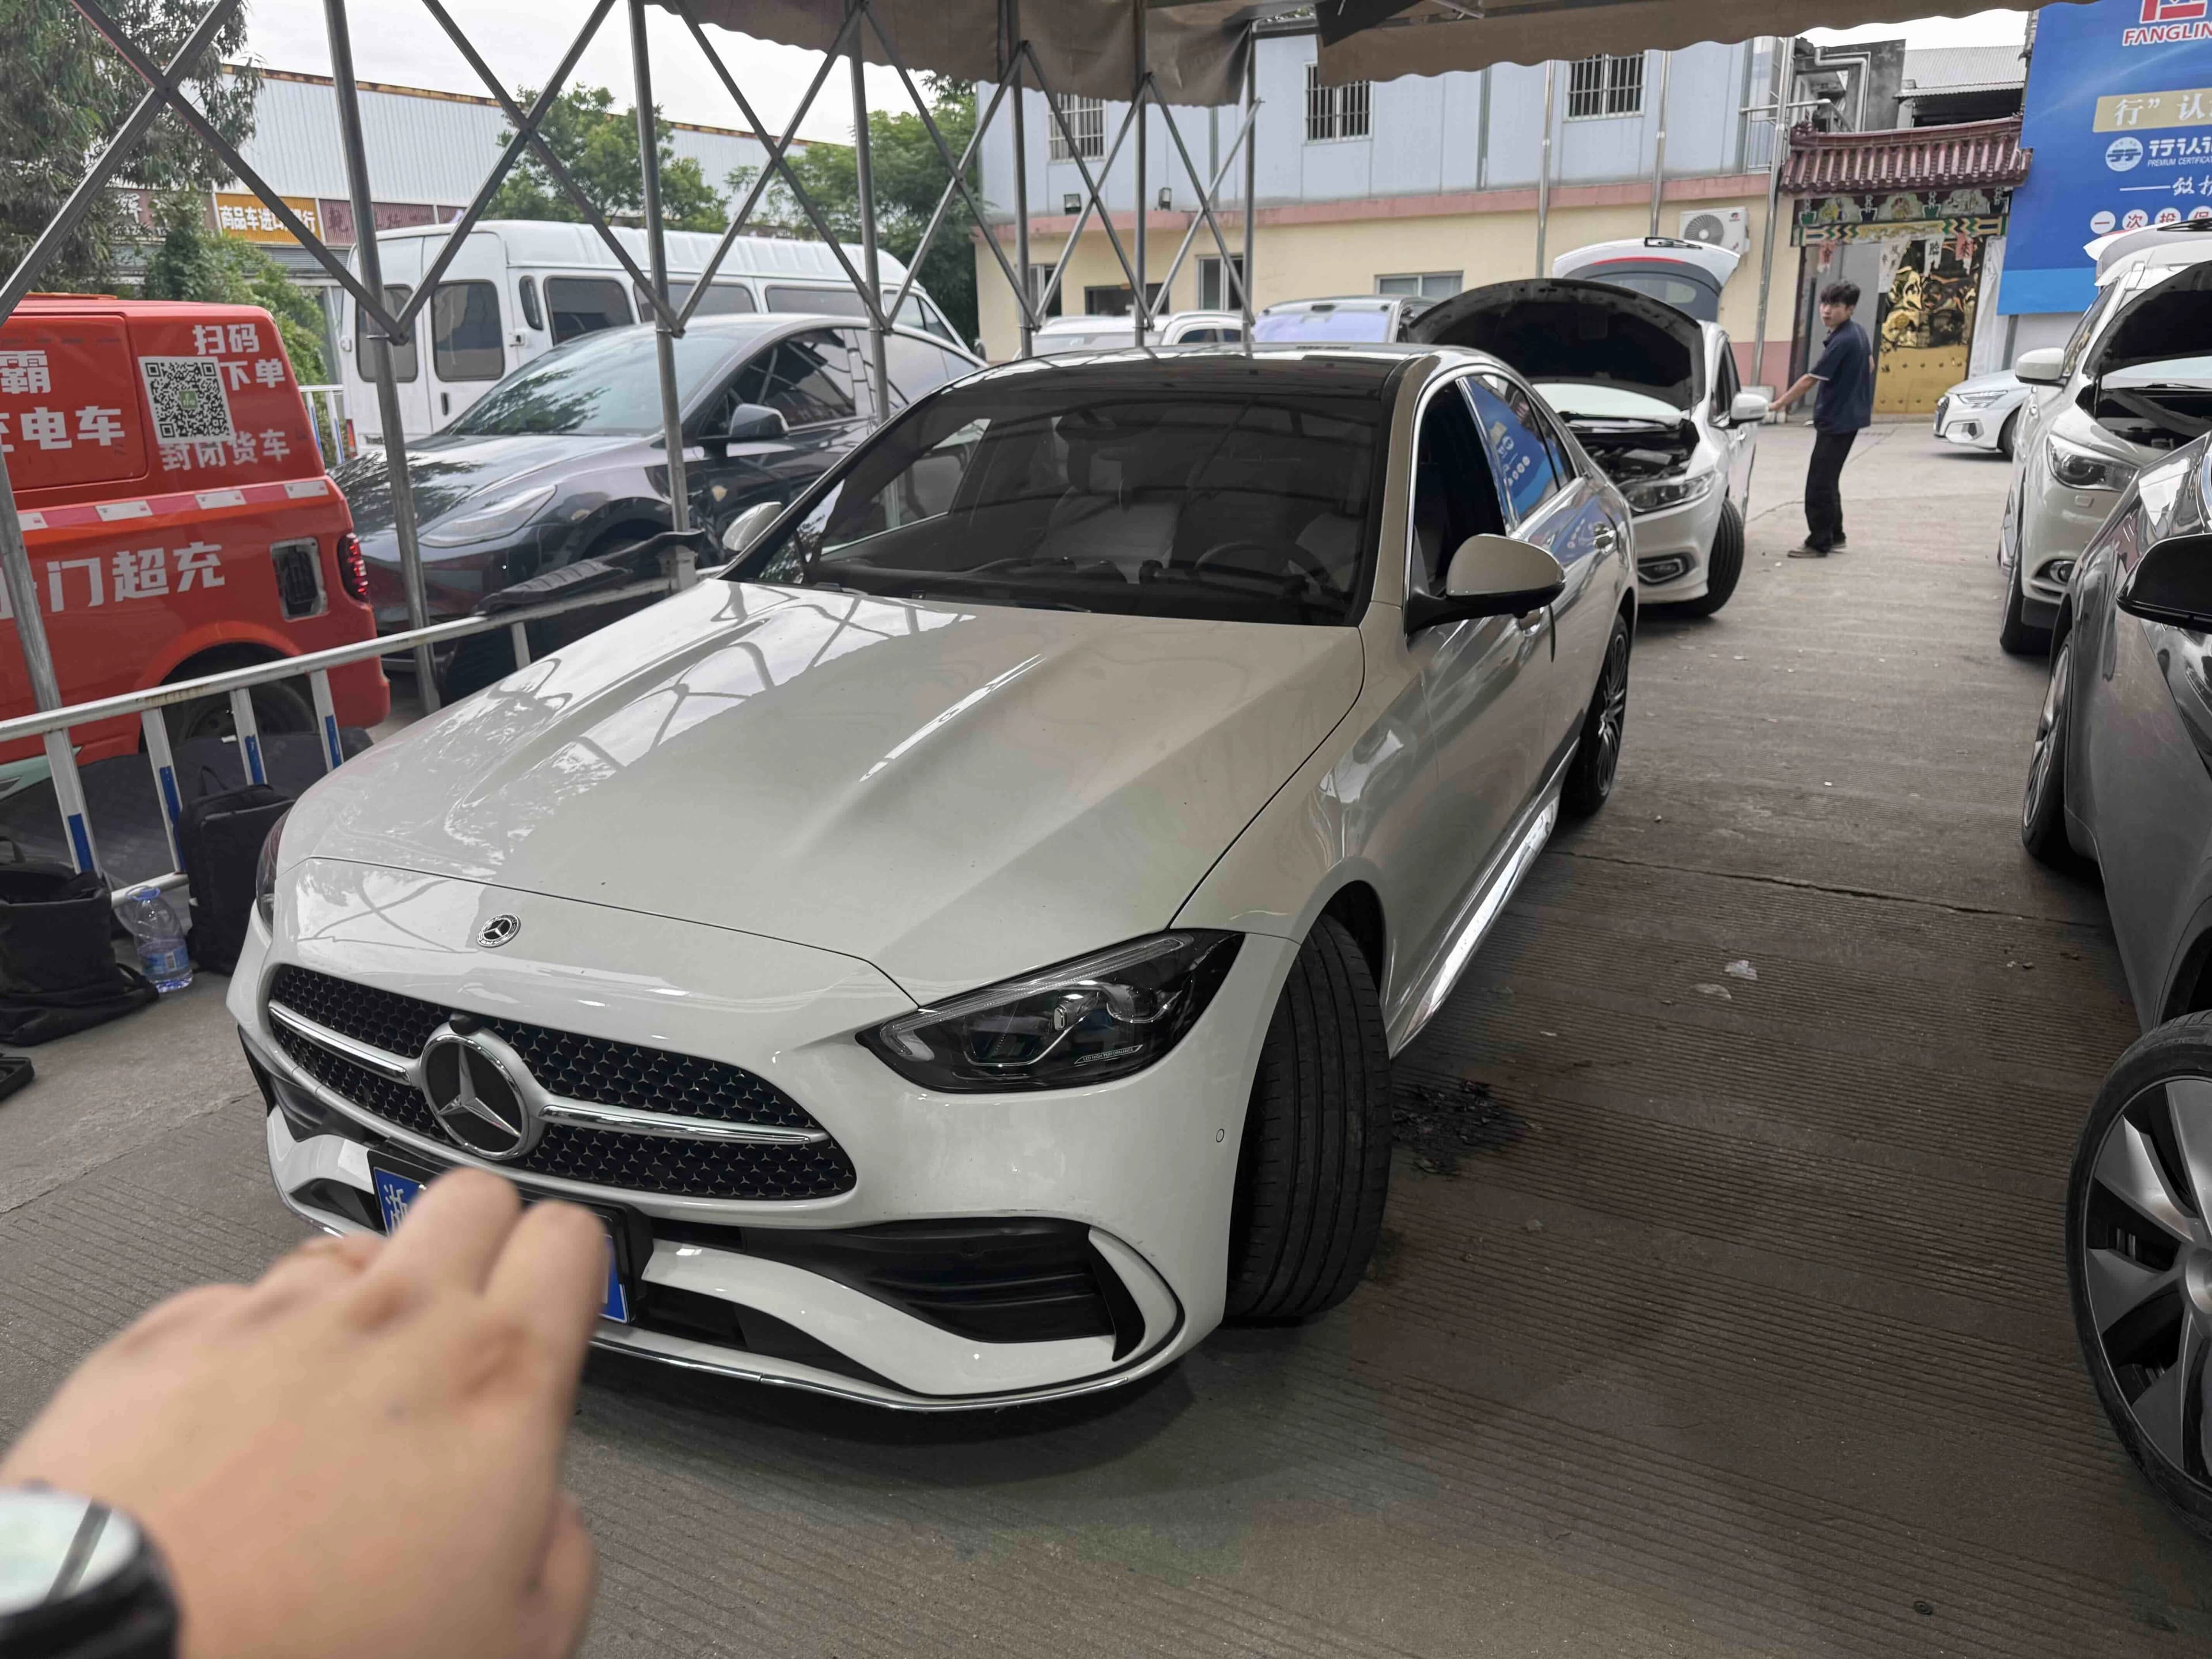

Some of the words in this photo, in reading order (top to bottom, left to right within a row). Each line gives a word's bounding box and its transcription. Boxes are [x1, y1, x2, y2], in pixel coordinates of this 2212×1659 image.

[2147, 158, 2176, 168] PREMIUM
[192, 323, 260, 355] 扫码
[0, 350, 51, 394] 霸
[219, 358, 286, 391] 下单
[159, 429, 290, 471] 封闭货车
[1103, 1047, 1134, 1058] PERFORMANCE
